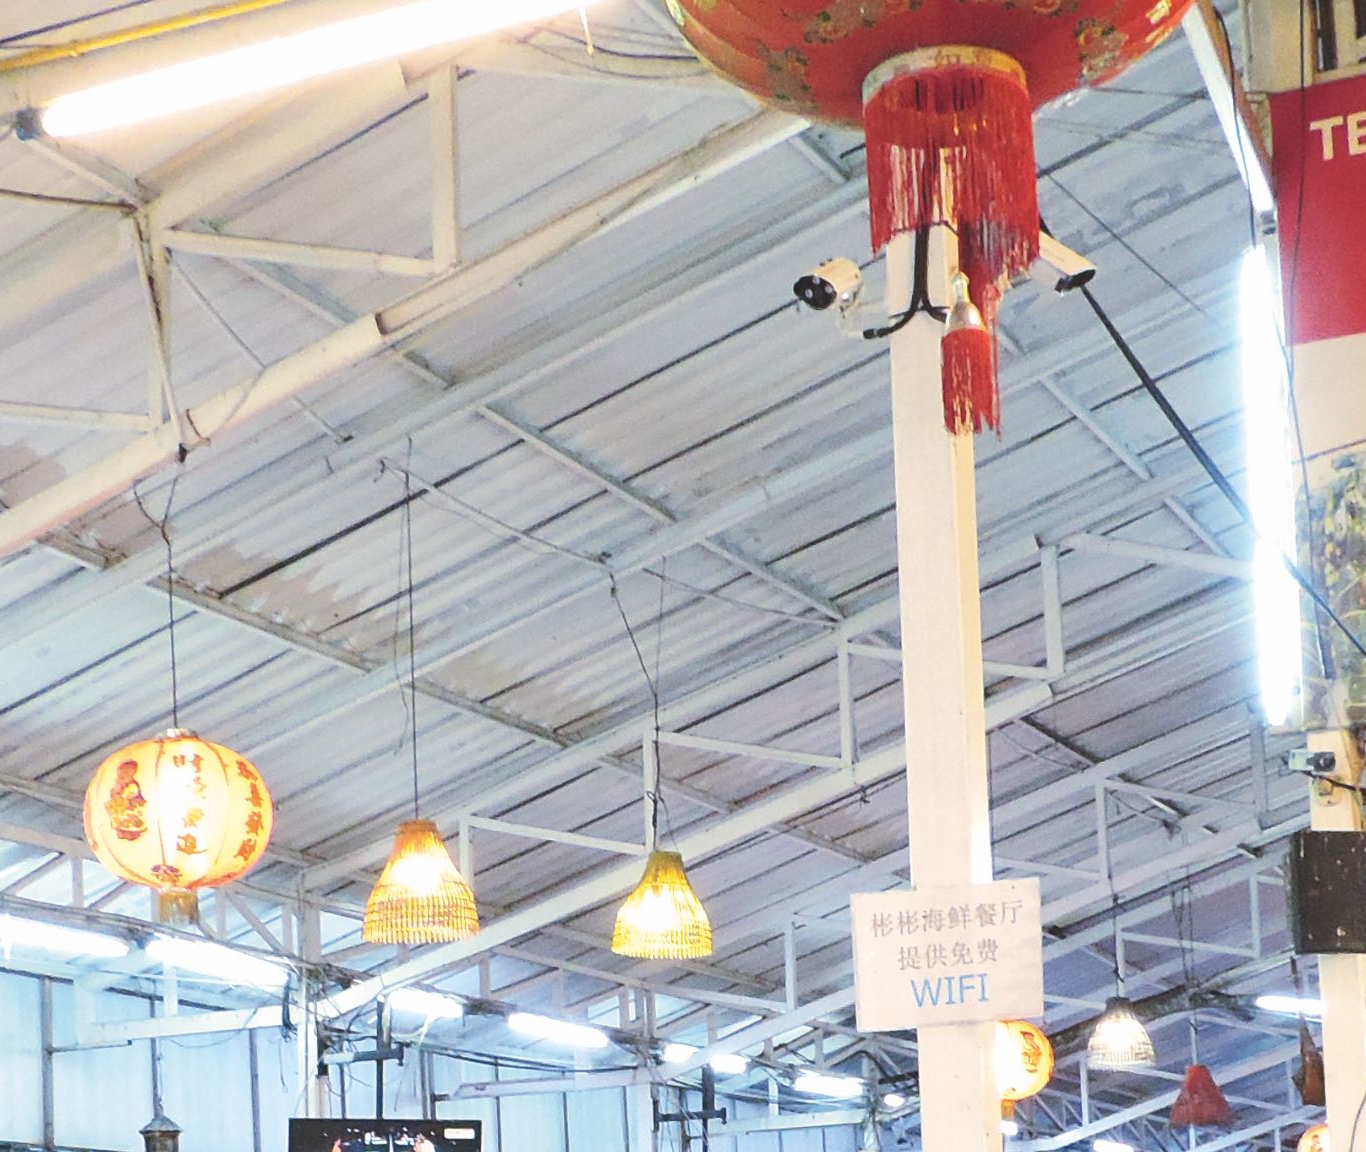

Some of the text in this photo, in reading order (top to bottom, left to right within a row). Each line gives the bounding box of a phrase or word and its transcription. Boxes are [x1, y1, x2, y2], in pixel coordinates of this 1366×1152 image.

[870, 899, 1024, 938] 彬彬海鲜餐厅
[897, 938, 999, 971] 提供免费
[909, 972, 990, 1008] WIFI
